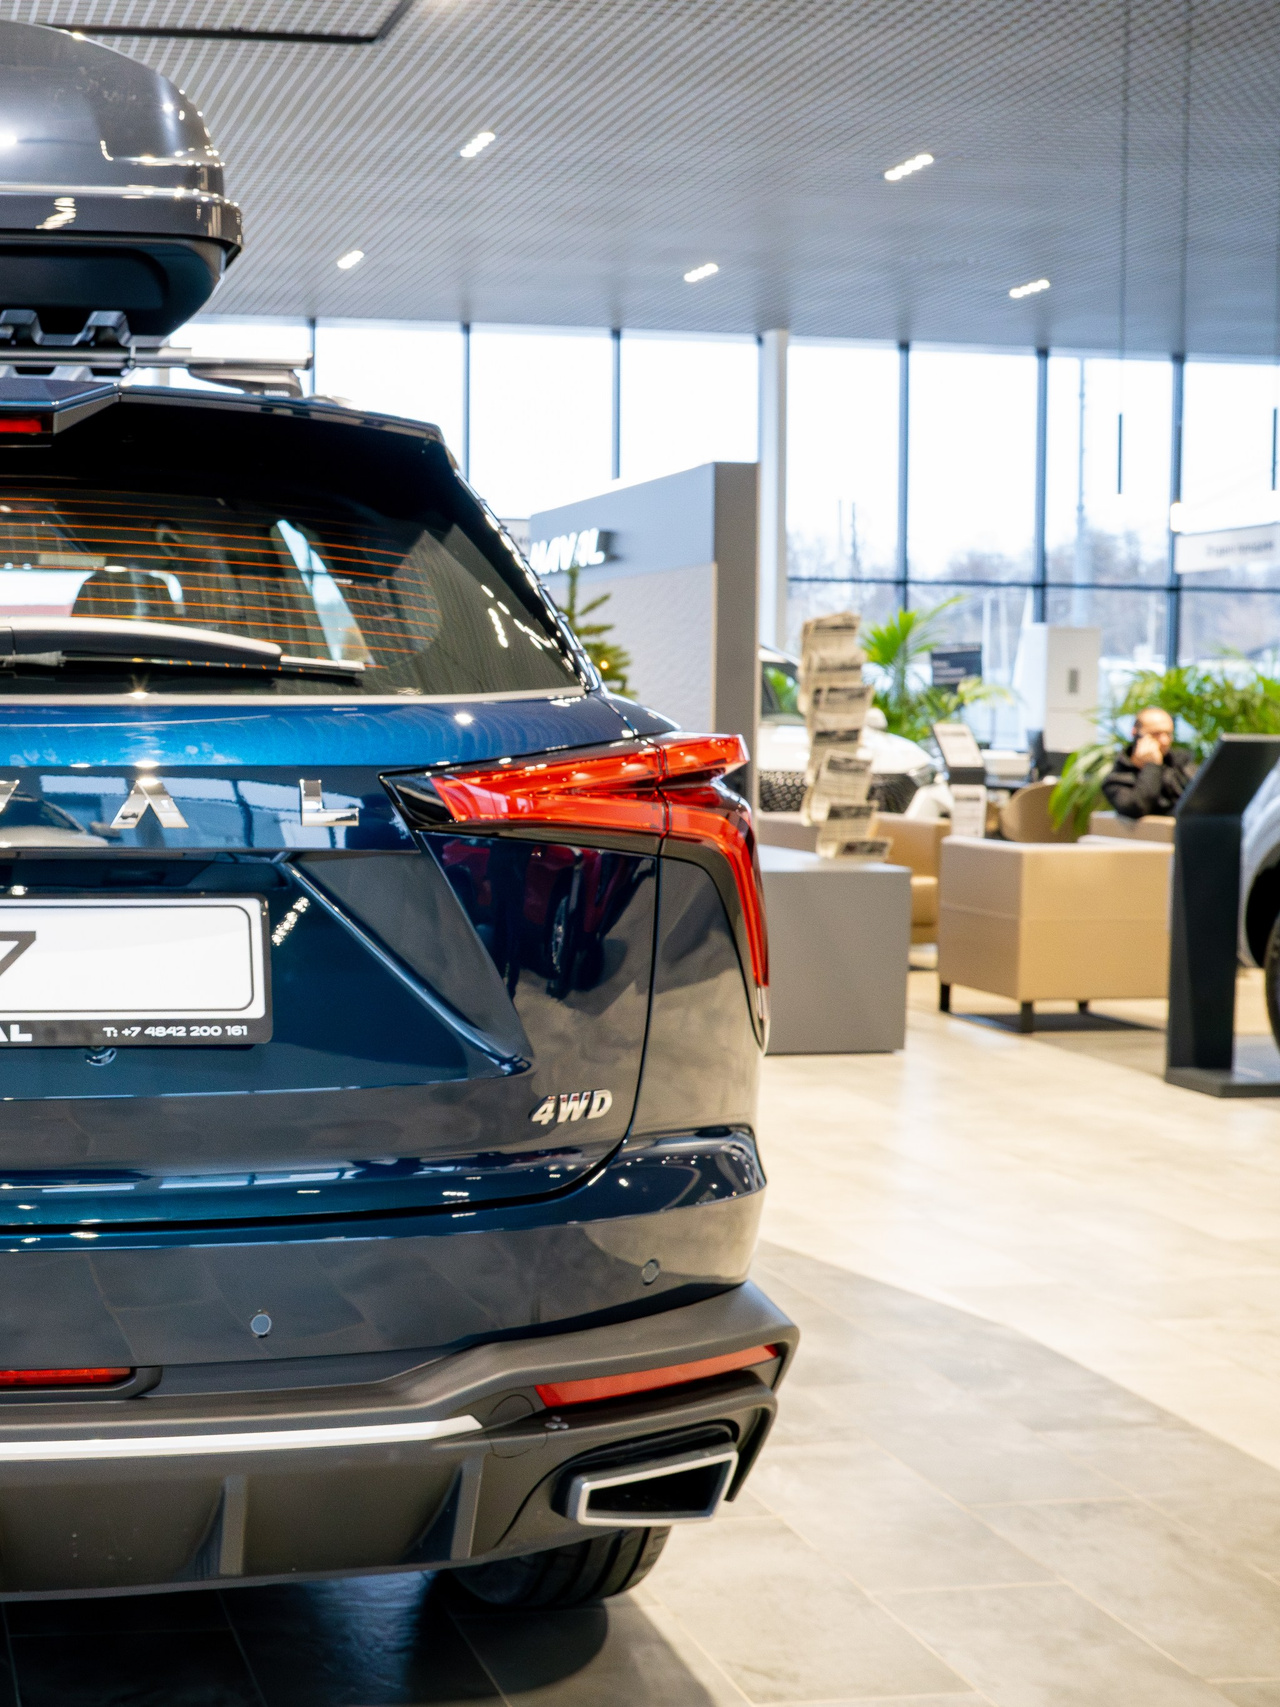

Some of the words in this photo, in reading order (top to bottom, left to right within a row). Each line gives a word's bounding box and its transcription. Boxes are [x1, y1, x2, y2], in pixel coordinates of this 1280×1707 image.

[121, 1026, 142, 1038] +7
[144, 1025, 187, 1037] 4842
[189, 1025, 223, 1037] 200
[225, 1025, 248, 1036] 161
[530, 1088, 613, 1126] 4WD
